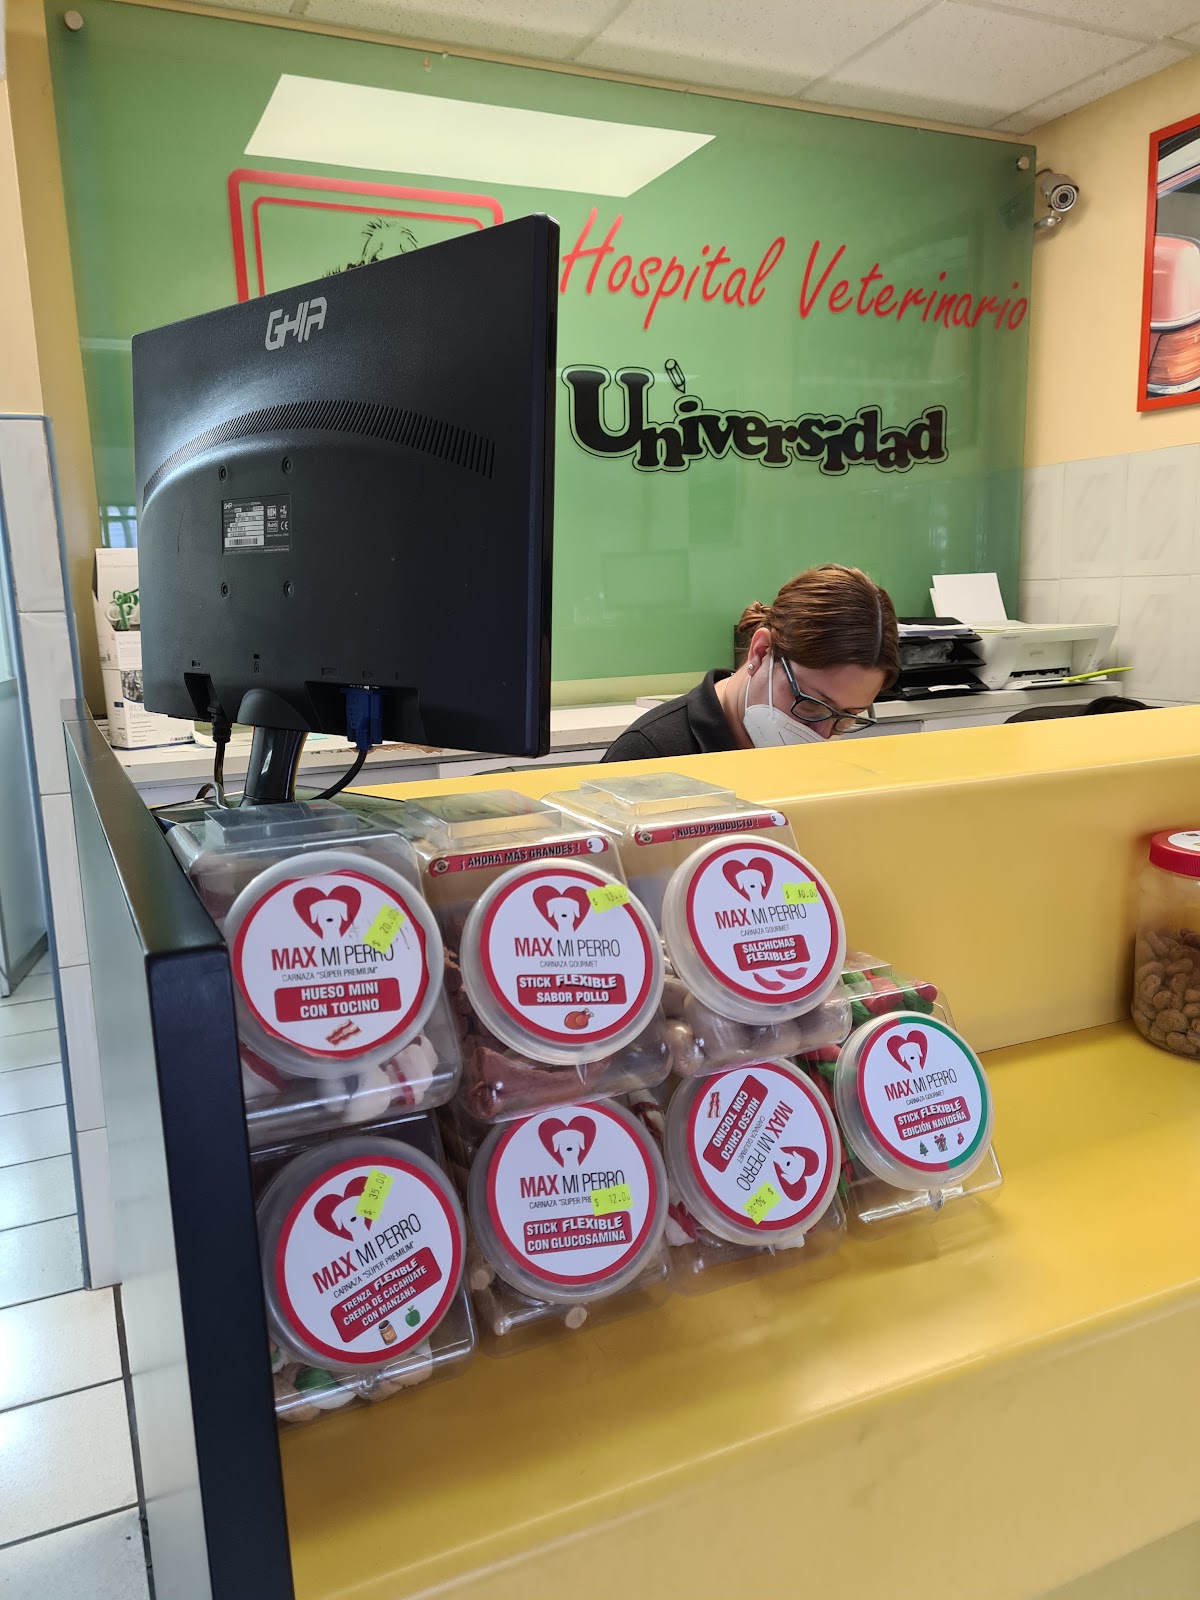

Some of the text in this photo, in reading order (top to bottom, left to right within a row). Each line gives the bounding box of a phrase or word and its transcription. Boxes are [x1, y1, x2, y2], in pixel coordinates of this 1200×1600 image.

[558, 207, 1028, 331] Hospital Veterinario
[264, 296, 327, 351] GHIA
[562, 365, 947, 475] Universidad
[677, 825, 706, 838] NUEVO
[708, 819, 754, 834] PRODUCTO
[468, 855, 503, 868] AHORA
[504, 849, 528, 863] MÁS
[530, 845, 575, 860] GRANDES
[714, 904, 807, 930] MAX MI PERRO
[740, 924, 790, 937] CARNAZA GOURMET
[515, 937, 621, 957] MAX MI PERRO
[741, 937, 796, 954] SALCHICHAS
[271, 946, 318, 970] MAX
[322, 947, 341, 967] MI
[539, 960, 598, 968] CARNAZA GOURMET
[746, 949, 797, 966] FLEXIBLES
[282, 972, 315, 982] CARNAZA
[519, 974, 617, 989] STICK FLEXIBLE
[301, 982, 379, 1001] HUESO MINI
[536, 991, 610, 1003] SABOR POLLO
[300, 998, 380, 1018] CON TOCINO
[884, 1068, 958, 1101] MAX MI PERRO
[905, 1090, 945, 1106] CARNAZA GOURMET
[712, 1090, 749, 1149] CON TOCINO
[897, 1100, 963, 1126] STICK FLEXIBLE
[902, 1111, 967, 1138] EDICIÓN NAVIDEÑA
[720, 1097, 760, 1160] HUESO CHICO
[736, 1115, 766, 1163] CARNAZA GOURMET
[736, 1100, 794, 1192] MAX MI PERRO
[520, 1169, 625, 1198] MAX MI PERRO
[529, 1199, 558, 1209] CARNAZA
[526, 1216, 623, 1236] STICK FLEXIBLE
[527, 1230, 627, 1252] CON GLUCOSAMINA
[312, 1213, 422, 1294] MAX MI PERRO
[333, 1276, 363, 1299] CARNAZA
[341, 1258, 419, 1312] TRENZA FLEXIBLE
[343, 1265, 428, 1326] CREMA DE CACAHUATE
[361, 1286, 417, 1327] CON MANZANA
